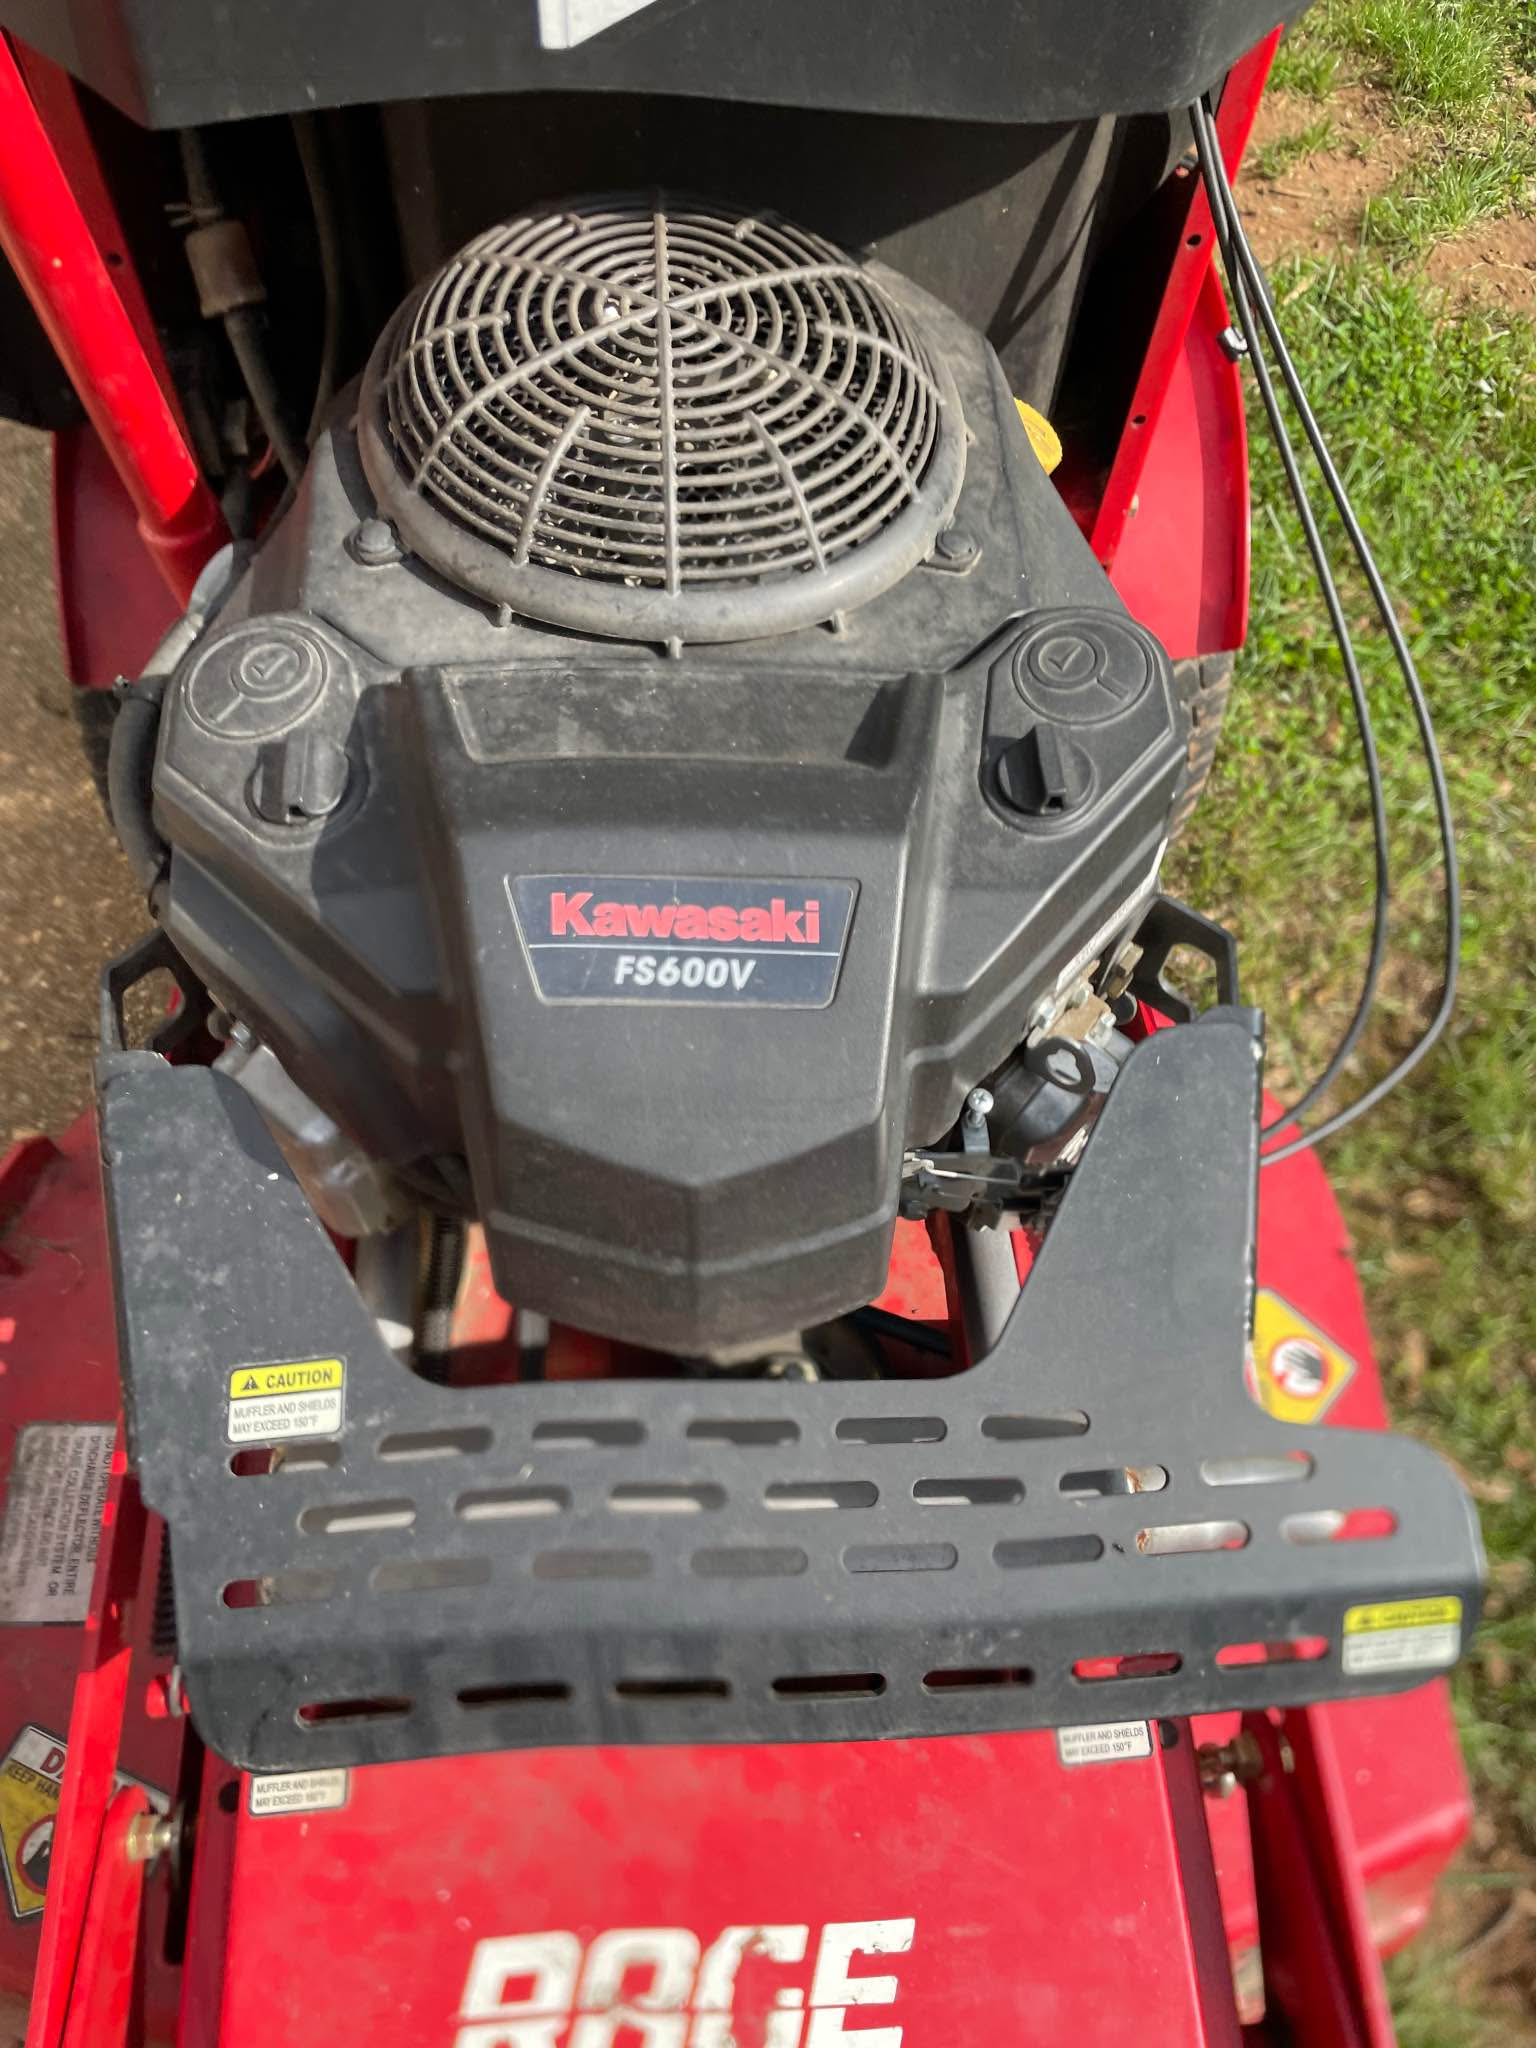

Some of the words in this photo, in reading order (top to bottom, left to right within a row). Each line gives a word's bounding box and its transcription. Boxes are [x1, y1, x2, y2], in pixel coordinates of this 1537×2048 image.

[550, 892, 820, 943] Kawasaki
[614, 955, 756, 990] FS600V
[266, 1367, 333, 1389] CAUTION
[233, 1404, 276, 1419] MUFFLER
[278, 1402, 296, 1415] AND
[297, 1398, 337, 1412] SHIELDS
[232, 1422, 253, 1434] MAY
[254, 1418, 290, 1432] EXCEED
[63, 1558, 81, 1594] ENTIRE
[1113, 1727, 1144, 1737] SHIELDS
[8, 1765, 36, 1784] KEEP
